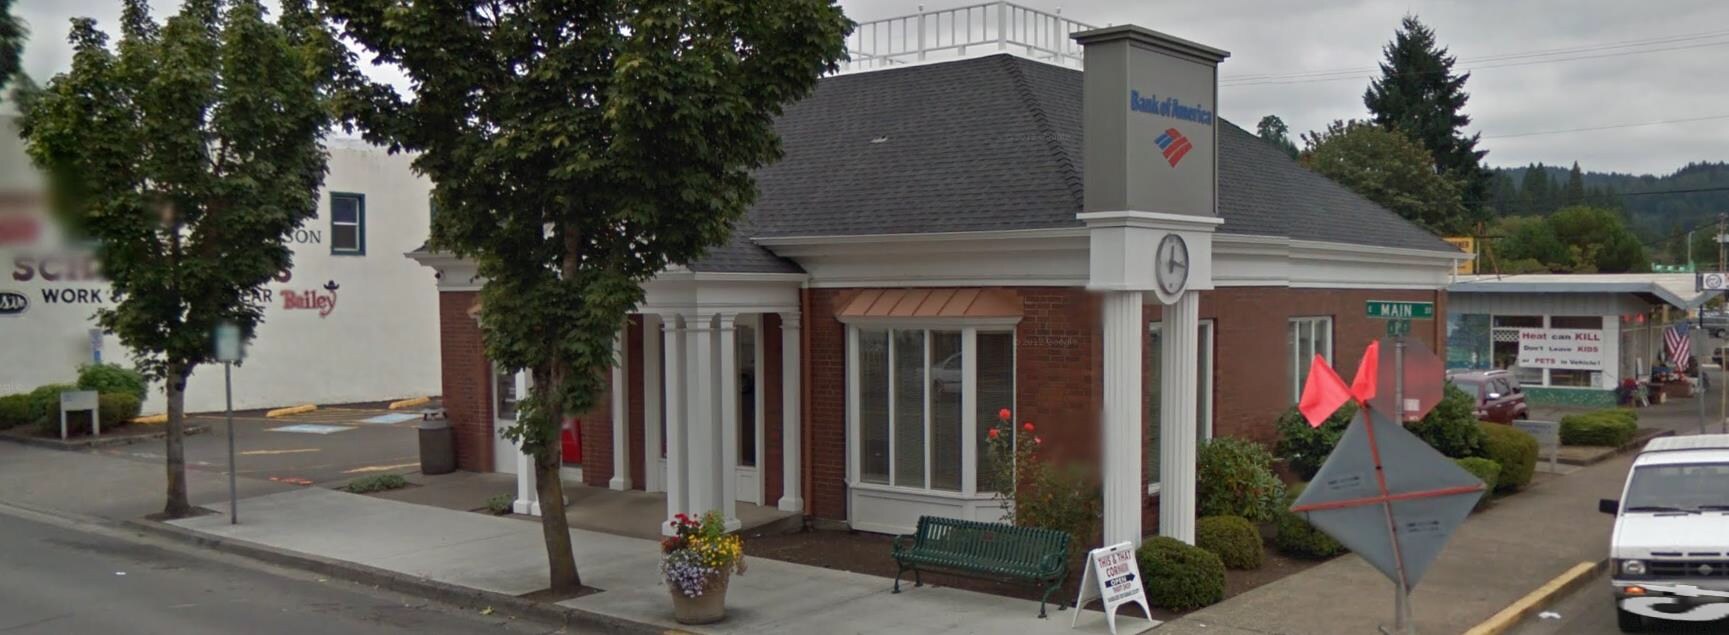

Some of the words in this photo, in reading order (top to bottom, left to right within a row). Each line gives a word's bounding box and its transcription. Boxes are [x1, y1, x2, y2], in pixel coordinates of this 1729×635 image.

[1131, 90, 1160, 114] Bank
[1160, 97, 1172, 118] of
[1172, 99, 1212, 125] America
[41, 288, 102, 304] WORK
[280, 289, 337, 318] Bailey
[1381, 303, 1412, 317] MAIN
[1522, 332, 1547, 341] Heat
[1575, 333, 1600, 342] KILL
[1098, 555, 1111, 568] THIS
[1117, 550, 1131, 561] THAT
[1110, 575, 1126, 586] OPEN
